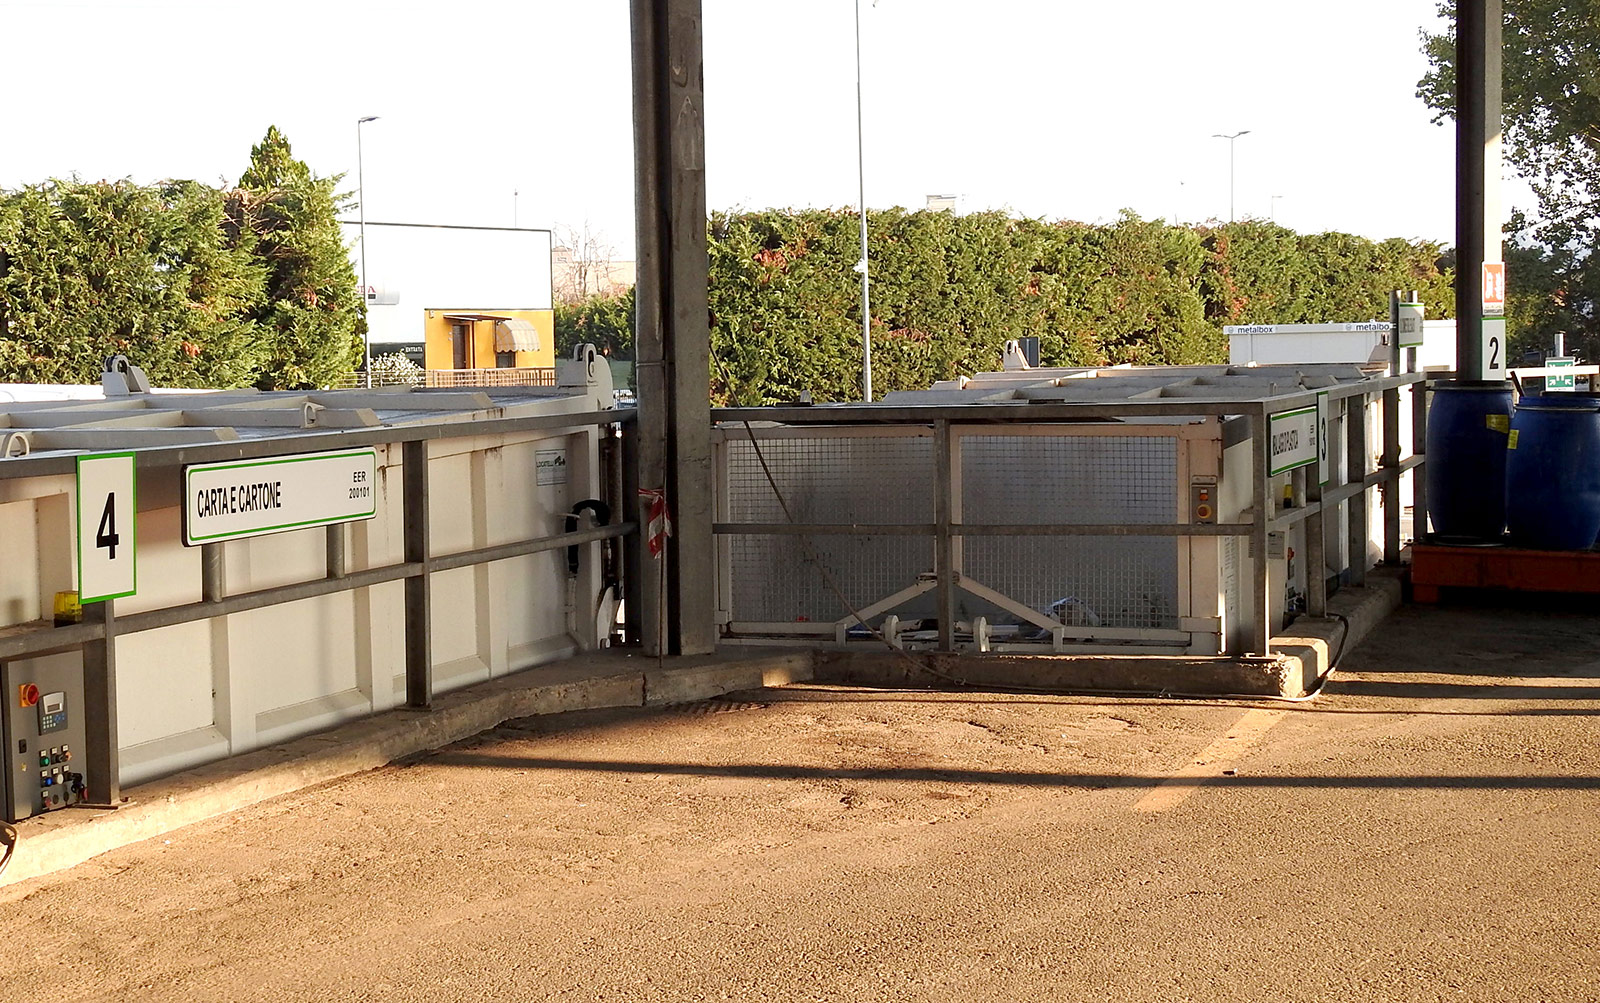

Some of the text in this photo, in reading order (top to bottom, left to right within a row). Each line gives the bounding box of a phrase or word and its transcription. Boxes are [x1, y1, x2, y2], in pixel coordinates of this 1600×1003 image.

[1237, 326, 1273, 334] metalbox
[1355, 323, 1390, 331] metalbo
[1489, 336, 1499, 370] 2
[1321, 417, 1327, 461] 3
[353, 471, 367, 483] EER
[197, 481, 282, 518] CARTA E CARTONE
[349, 486, 370, 499] 200101
[96, 492, 120, 560] 4
